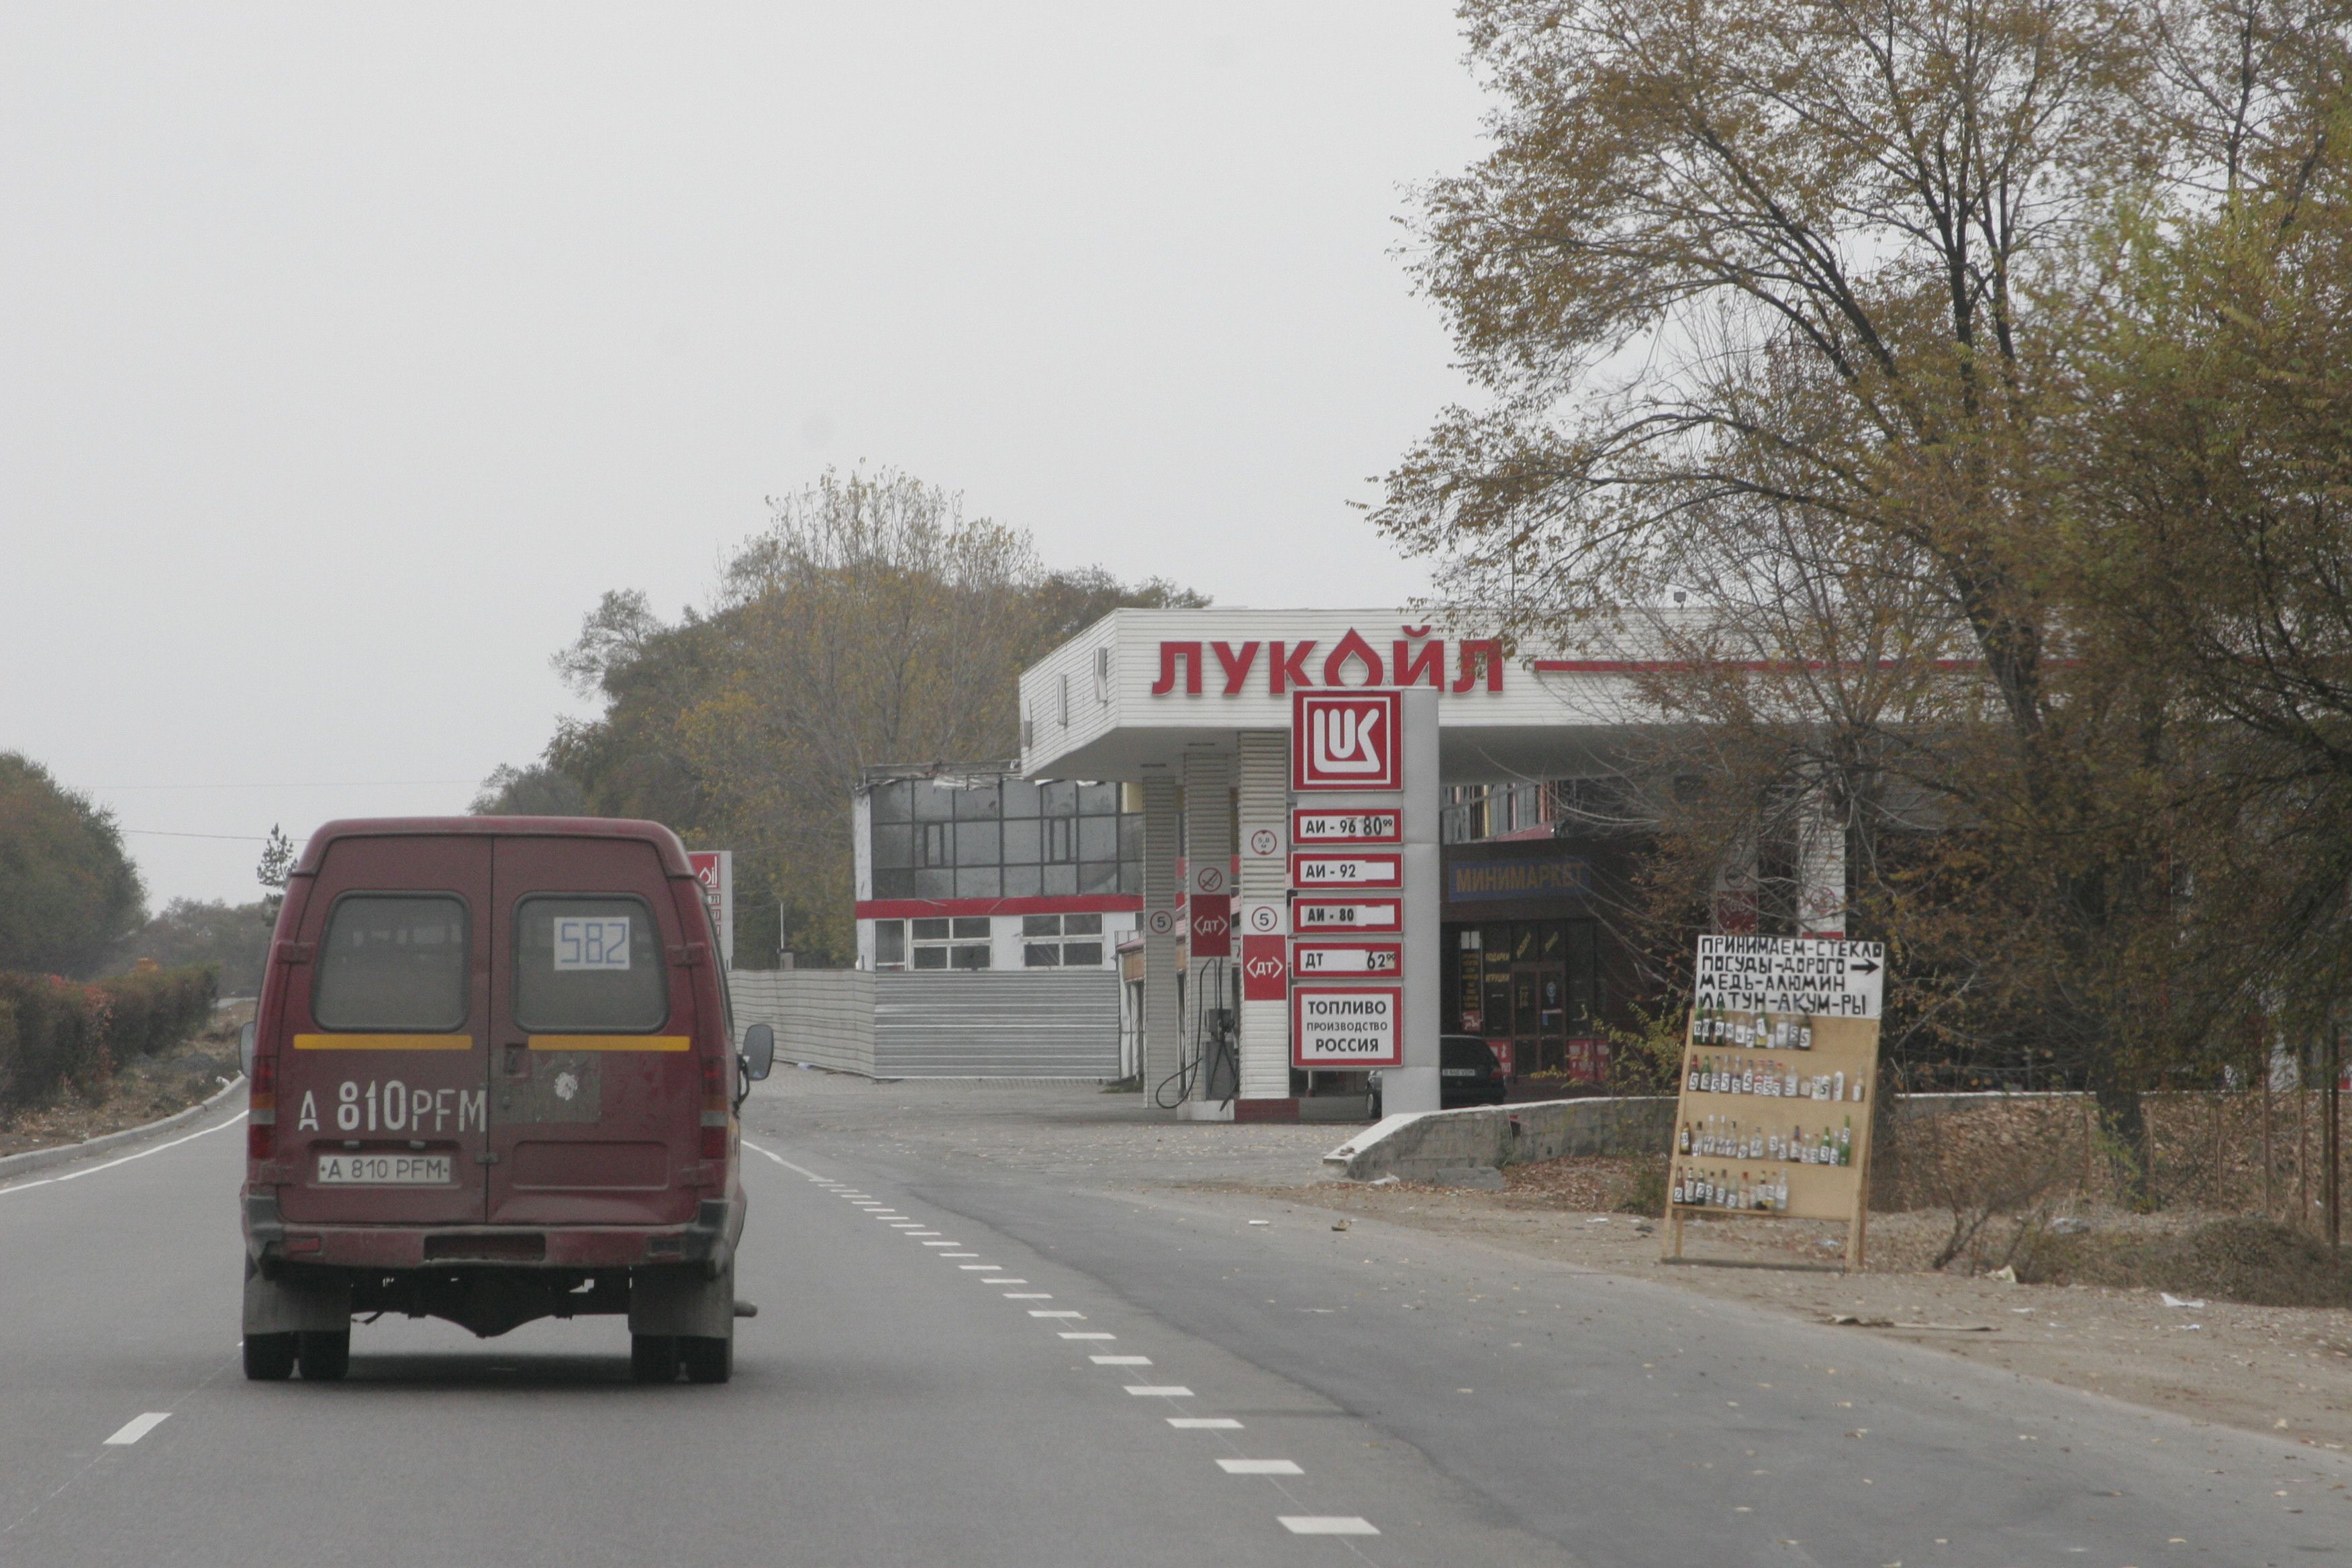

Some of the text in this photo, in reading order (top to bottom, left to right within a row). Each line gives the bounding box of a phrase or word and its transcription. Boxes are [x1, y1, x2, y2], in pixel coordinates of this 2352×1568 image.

[1152, 626, 1503, 695] ЛУКОЙЛ
[1306, 820, 1326, 834] АИ
[1339, 819, 1356, 834] 96
[1306, 864, 1326, 878] АИ
[1339, 864, 1356, 878] 92
[1456, 861, 1585, 892] МИНИМАРКЕТ
[1157, 912, 1166, 928] 5
[1259, 914, 1269, 926] 5
[1308, 908, 1324, 922] АИ
[1339, 908, 1354, 922] 80
[1202, 920, 1220, 932] ДТ
[561, 923, 626, 963] 582
[1306, 953, 1324, 969] ДТ
[1256, 962, 1274, 975] ДТ
[1308, 1001, 1387, 1015] ТОПЛИВО
[1307, 1022, 1387, 1032] ПРОИЗВОДСТВО
[1316, 1038, 1379, 1052] РОССИЯ
[298, 1090, 319, 1132] A
[328, 1159, 442, 1179] A 810 PFM
